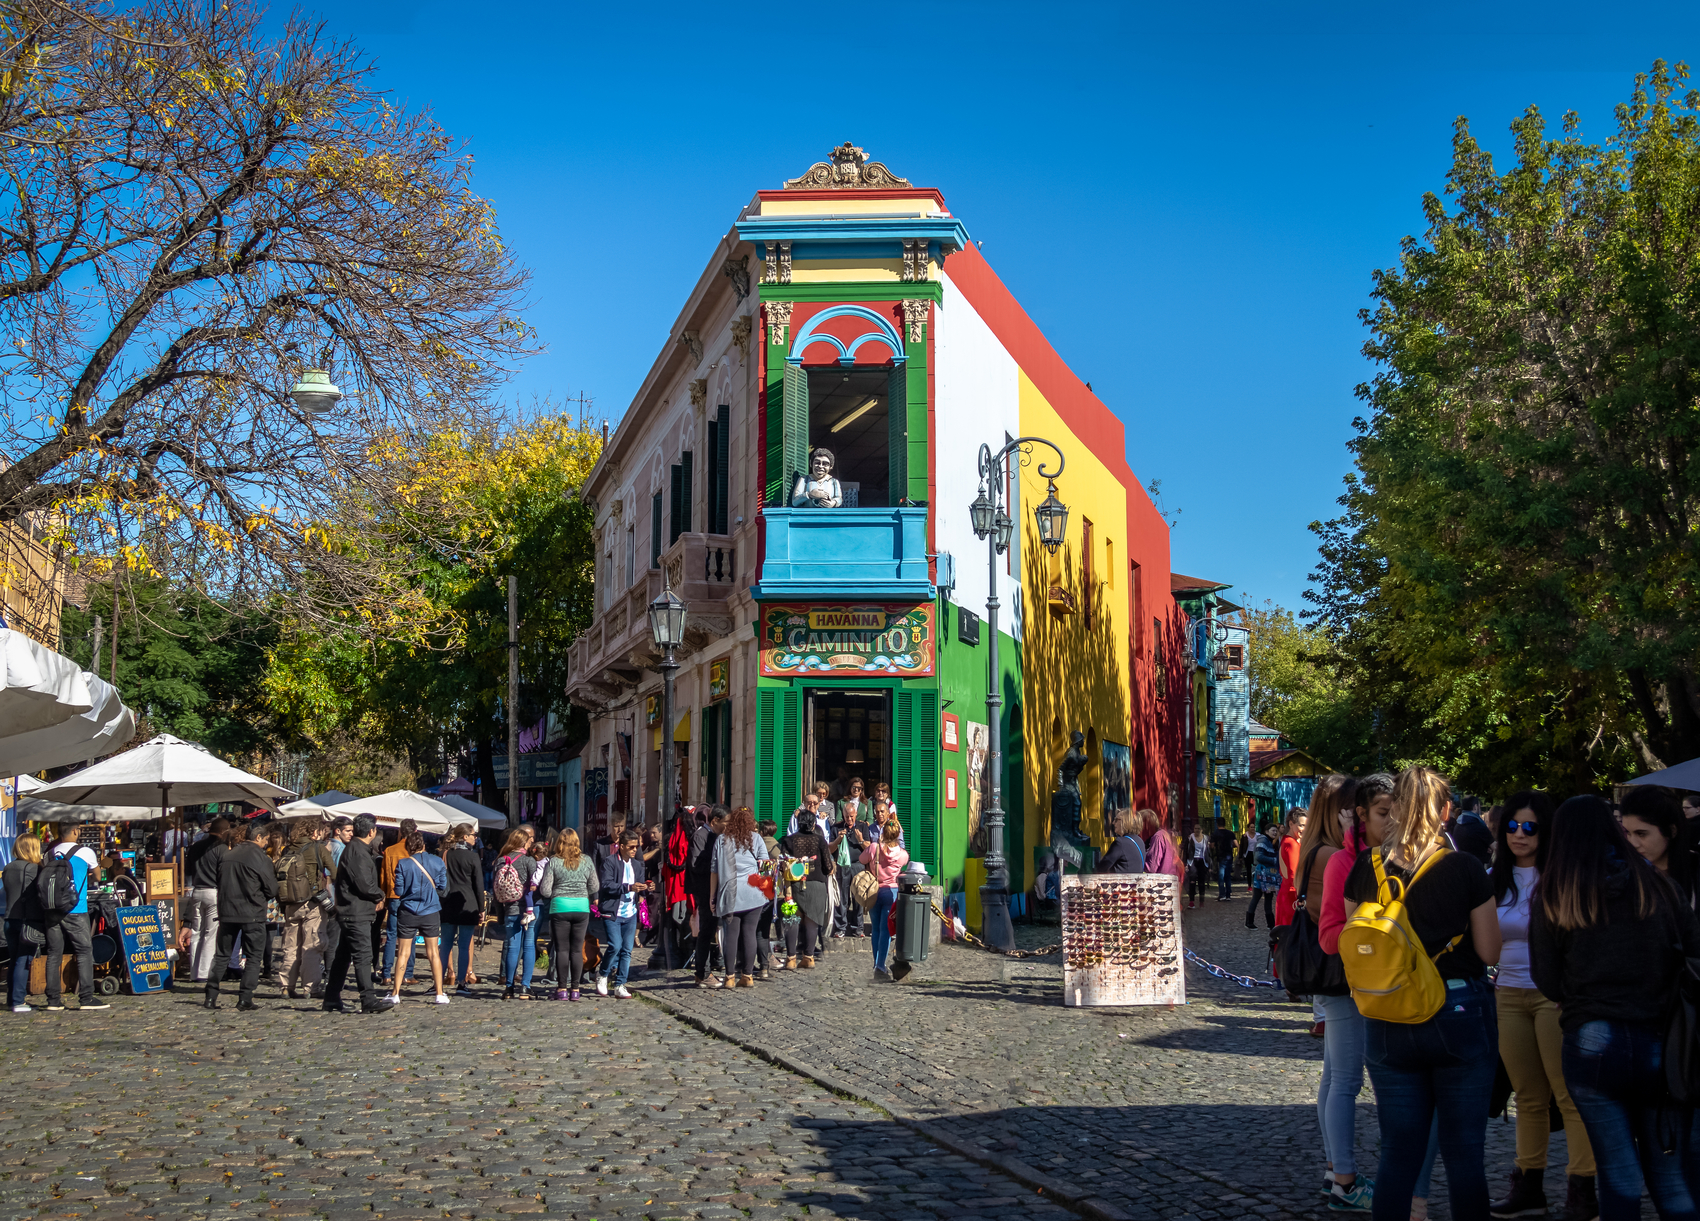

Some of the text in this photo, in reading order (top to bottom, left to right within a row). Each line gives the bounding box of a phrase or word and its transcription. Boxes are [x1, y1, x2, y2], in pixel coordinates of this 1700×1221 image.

[840, 163, 856, 175] 1891
[816, 614, 880, 626] HAVANNA
[776, 633, 781, 641] H
[787, 627, 908, 653] CAMINITO
[914, 633, 919, 641] H
[122, 914, 156, 925] CHOCOLATE
[124, 927, 137, 936] CON
[130, 951, 148, 964] CAFE
